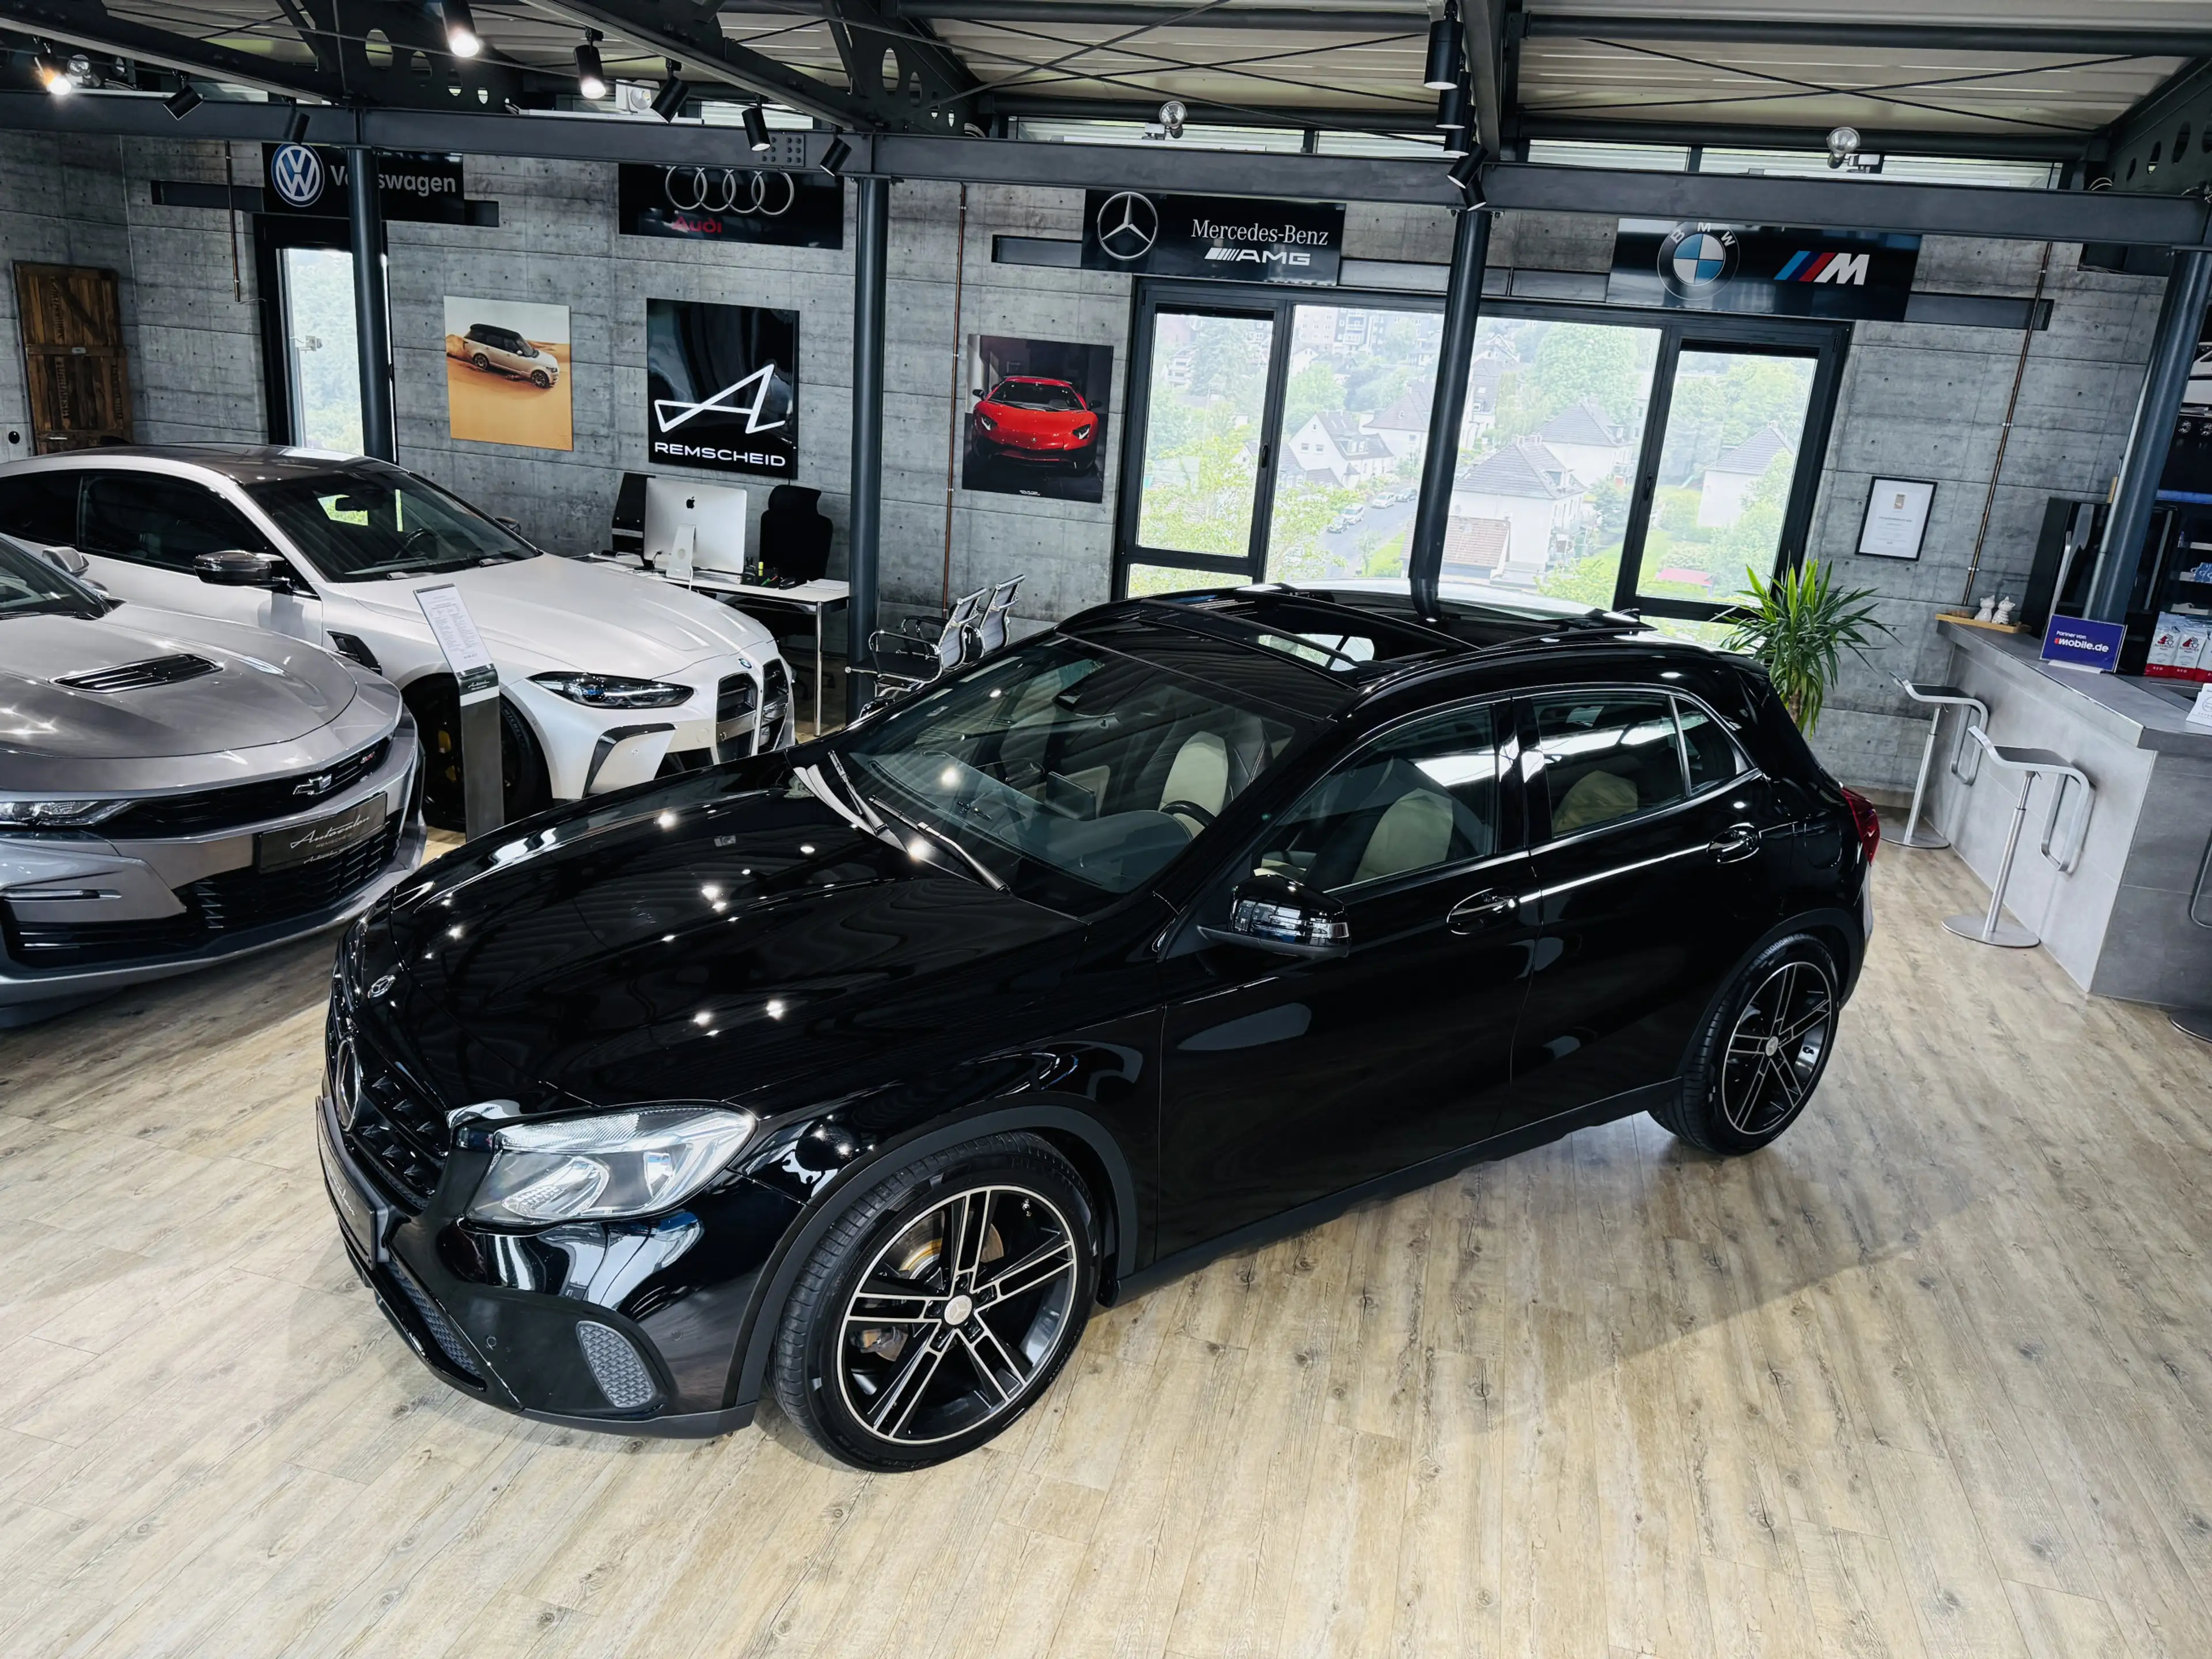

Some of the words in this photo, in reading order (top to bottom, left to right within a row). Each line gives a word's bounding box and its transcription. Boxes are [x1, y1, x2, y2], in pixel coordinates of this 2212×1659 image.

[330, 165, 456, 196] Vswagen
[671, 215, 722, 233] Audi
[1191, 219, 1328, 245] Mercedes-Benz
[1669, 221, 1736, 247] BMW
[1235, 249, 1310, 266] AMG
[654, 441, 786, 467] REMSCHEID
[2058, 638, 2109, 652] mobile.de
